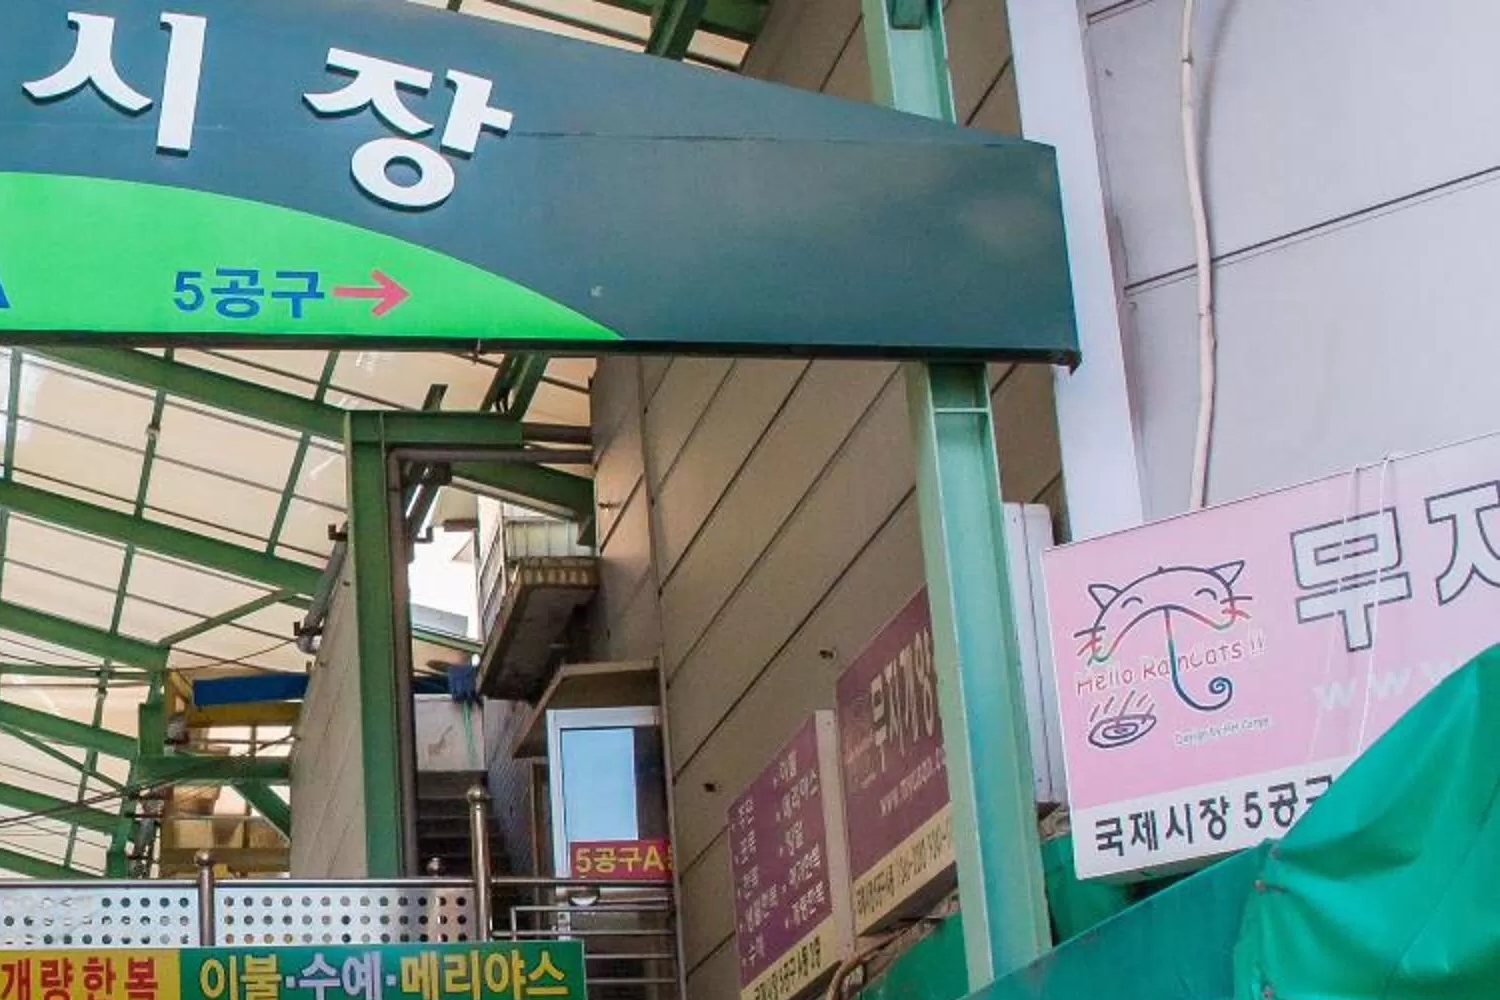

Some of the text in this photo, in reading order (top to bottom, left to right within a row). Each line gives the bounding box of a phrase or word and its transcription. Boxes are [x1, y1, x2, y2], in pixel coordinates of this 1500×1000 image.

[172, 267, 329, 321] 5공구
[1094, 796, 1231, 857] 국제시장
[575, 844, 675, 873] 5공구A
